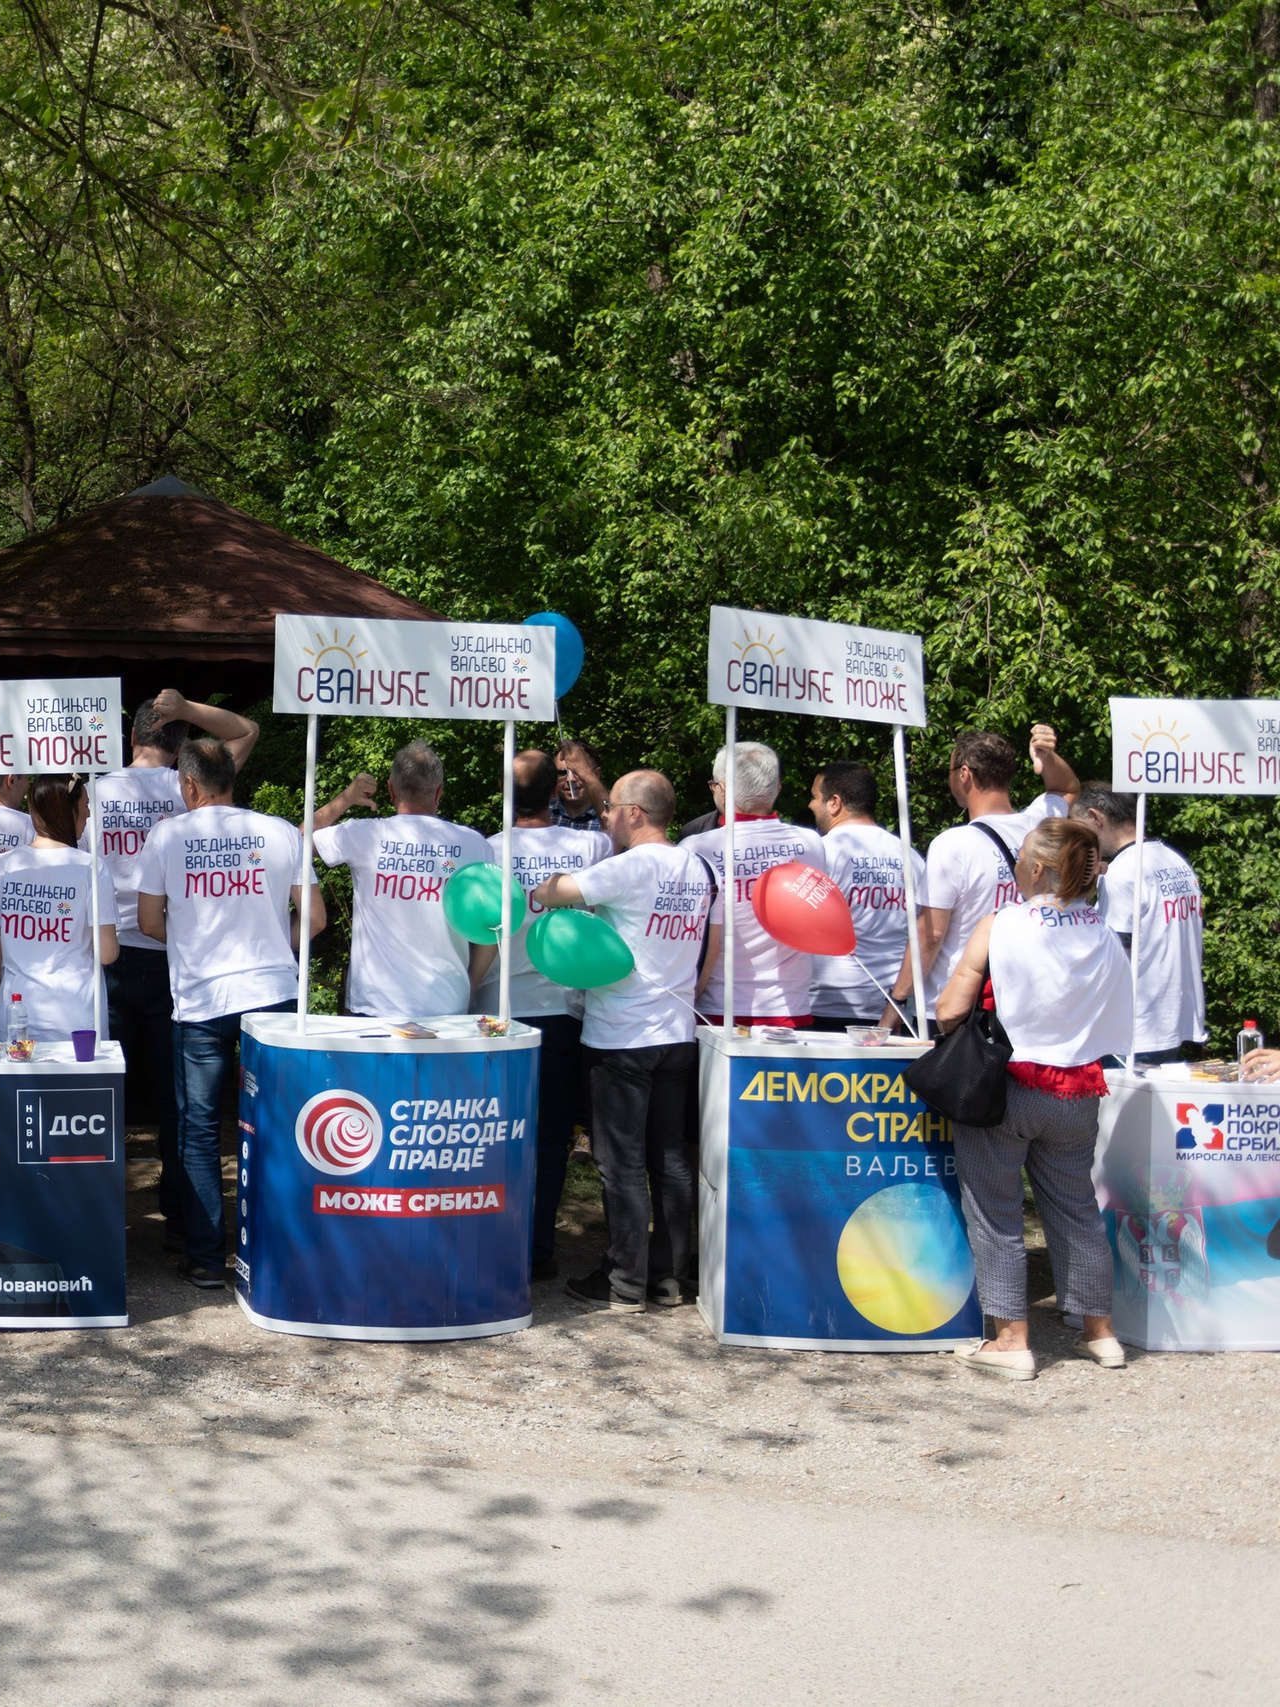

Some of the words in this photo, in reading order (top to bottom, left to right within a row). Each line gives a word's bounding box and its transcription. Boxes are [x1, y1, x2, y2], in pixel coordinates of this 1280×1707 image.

[451, 636, 532, 654] УЈЕДИЊЕНО
[846, 641, 906, 662] УЈЕДИЊЕНО
[450, 655, 506, 673] ВАЉЕВО
[846, 659, 888, 678] ВАЉЕВО
[297, 666, 431, 707] СВАНУЋЕ
[727, 660, 834, 703] СВАНУЋЕ
[450, 676, 531, 710] МОЖЕ
[846, 677, 907, 712] МОЖЕ
[27, 697, 107, 714] УЈЕДИЊЕНО
[27, 716, 82, 733] ВАЉЕВО
[1257, 719, 1280, 734] УЈЕ
[28, 735, 107, 767] МОЖЕ
[1128, 751, 1245, 784] СВАНУЋЕ
[102, 800, 174, 813] УЈЕДИЊЕНО
[103, 816, 152, 828] ВАЉЕВО
[185, 835, 265, 853] УЈЕДИЊЕНО
[381, 840, 461, 858] УЈЕДИЊЕНО
[713, 843, 805, 863] УЕДИЊЕНО
[185, 853, 241, 869] ВАЉЕВО
[378, 857, 434, 873] ВАЉЕВО
[512, 855, 584, 870] ЈЕДИЊЕНО
[185, 868, 265, 898] МОЖЕ
[374, 873, 448, 902] МОЖ
[852, 872, 895, 885] ВАЉЕВО
[3, 882, 76, 900] УЈЕДИЊЕНО
[1, 897, 51, 915] ВАЉЕВО
[655, 897, 696, 912] ВАЉЕВО
[1, 913, 73, 942] МОЖЕ
[390, 1097, 499, 1121] СТРАНКА
[49, 1114, 106, 1136] ДСС
[389, 1121, 507, 1147] СЛОБОДЕ
[511, 1119, 525, 1140] И
[846, 1111, 953, 1142] СТРАН
[1227, 1120, 1280, 1134] ПОКР
[388, 1148, 486, 1172] ПРАВДЕ
[847, 1155, 958, 1176] ВАЉЕВ
[1176, 1153, 1243, 1161] МИРОСЛАВ
[320, 1191, 402, 1211] МОЖЕ
[408, 1190, 499, 1212] СРБИЈА
